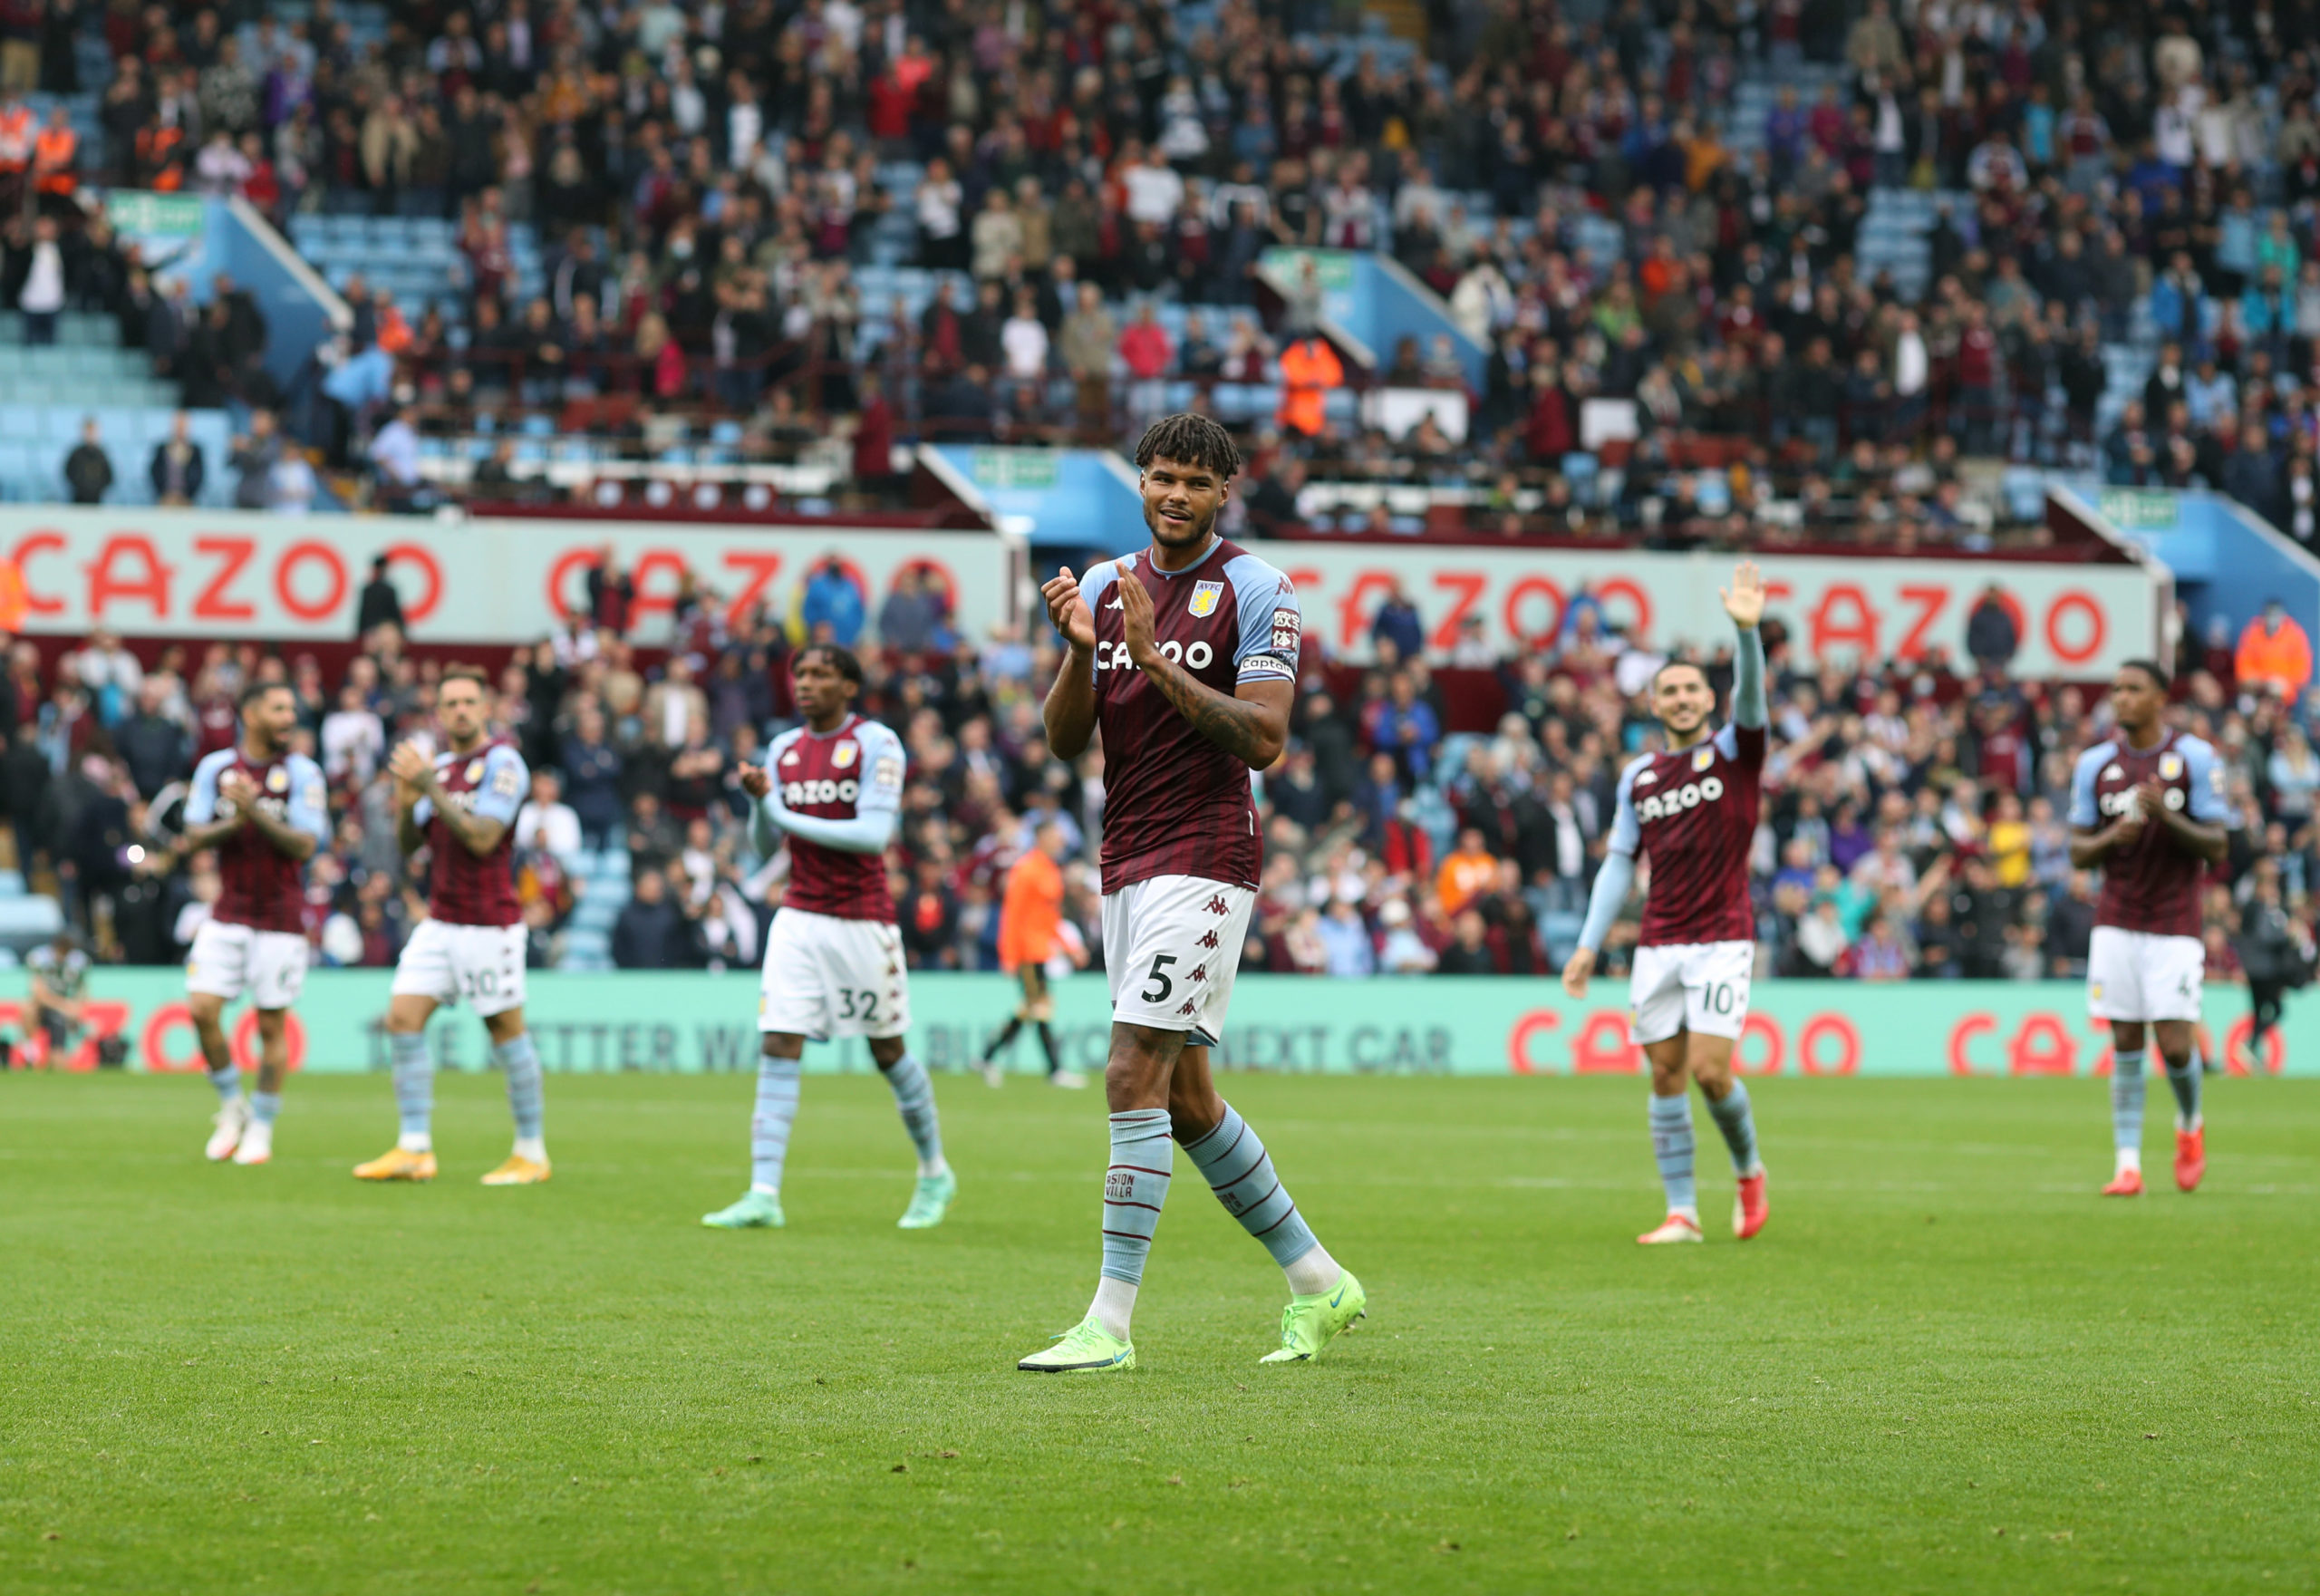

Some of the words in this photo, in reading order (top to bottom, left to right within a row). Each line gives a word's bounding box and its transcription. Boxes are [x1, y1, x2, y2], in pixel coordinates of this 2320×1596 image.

[9, 530, 442, 621] CAZOO
[1097, 640, 1213, 670] CAOO
[783, 779, 859, 806] AZOO
[1141, 954, 1177, 1003] 5
[838, 989, 879, 1021] 32
[1703, 982, 1734, 1015] 10
[1347, 1022, 1456, 1073] CAR
[1508, 1008, 1861, 1075] CAOO
[1106, 1185, 1132, 1197] VILLA
[1107, 1174, 1135, 1185] ASTON
